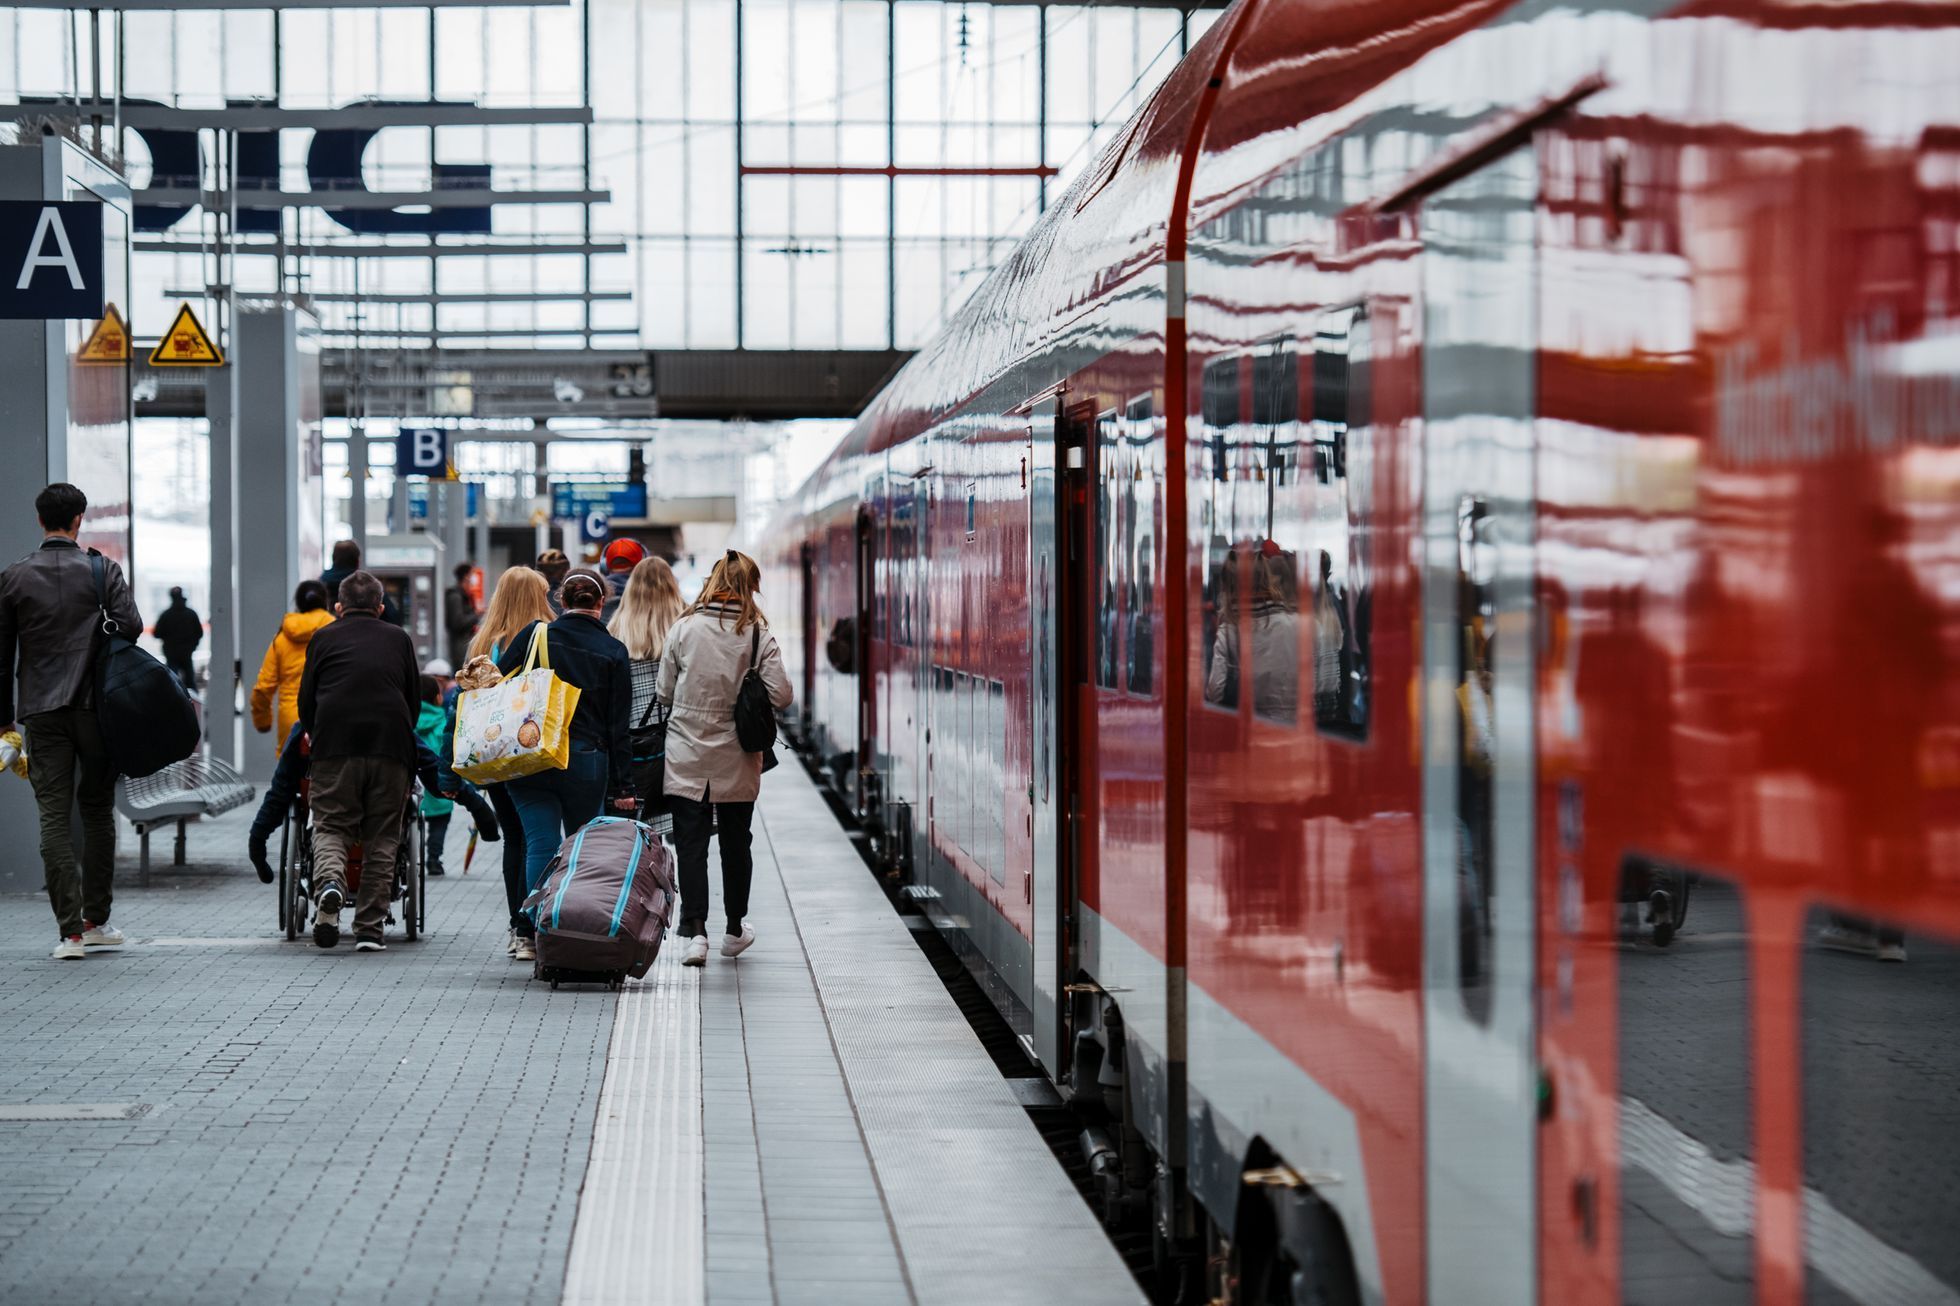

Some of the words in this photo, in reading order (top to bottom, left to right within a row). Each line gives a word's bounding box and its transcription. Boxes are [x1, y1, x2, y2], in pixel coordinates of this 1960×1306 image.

[16, 207, 86, 290] A
[413, 429, 443, 468] B
[586, 511, 608, 538] C
